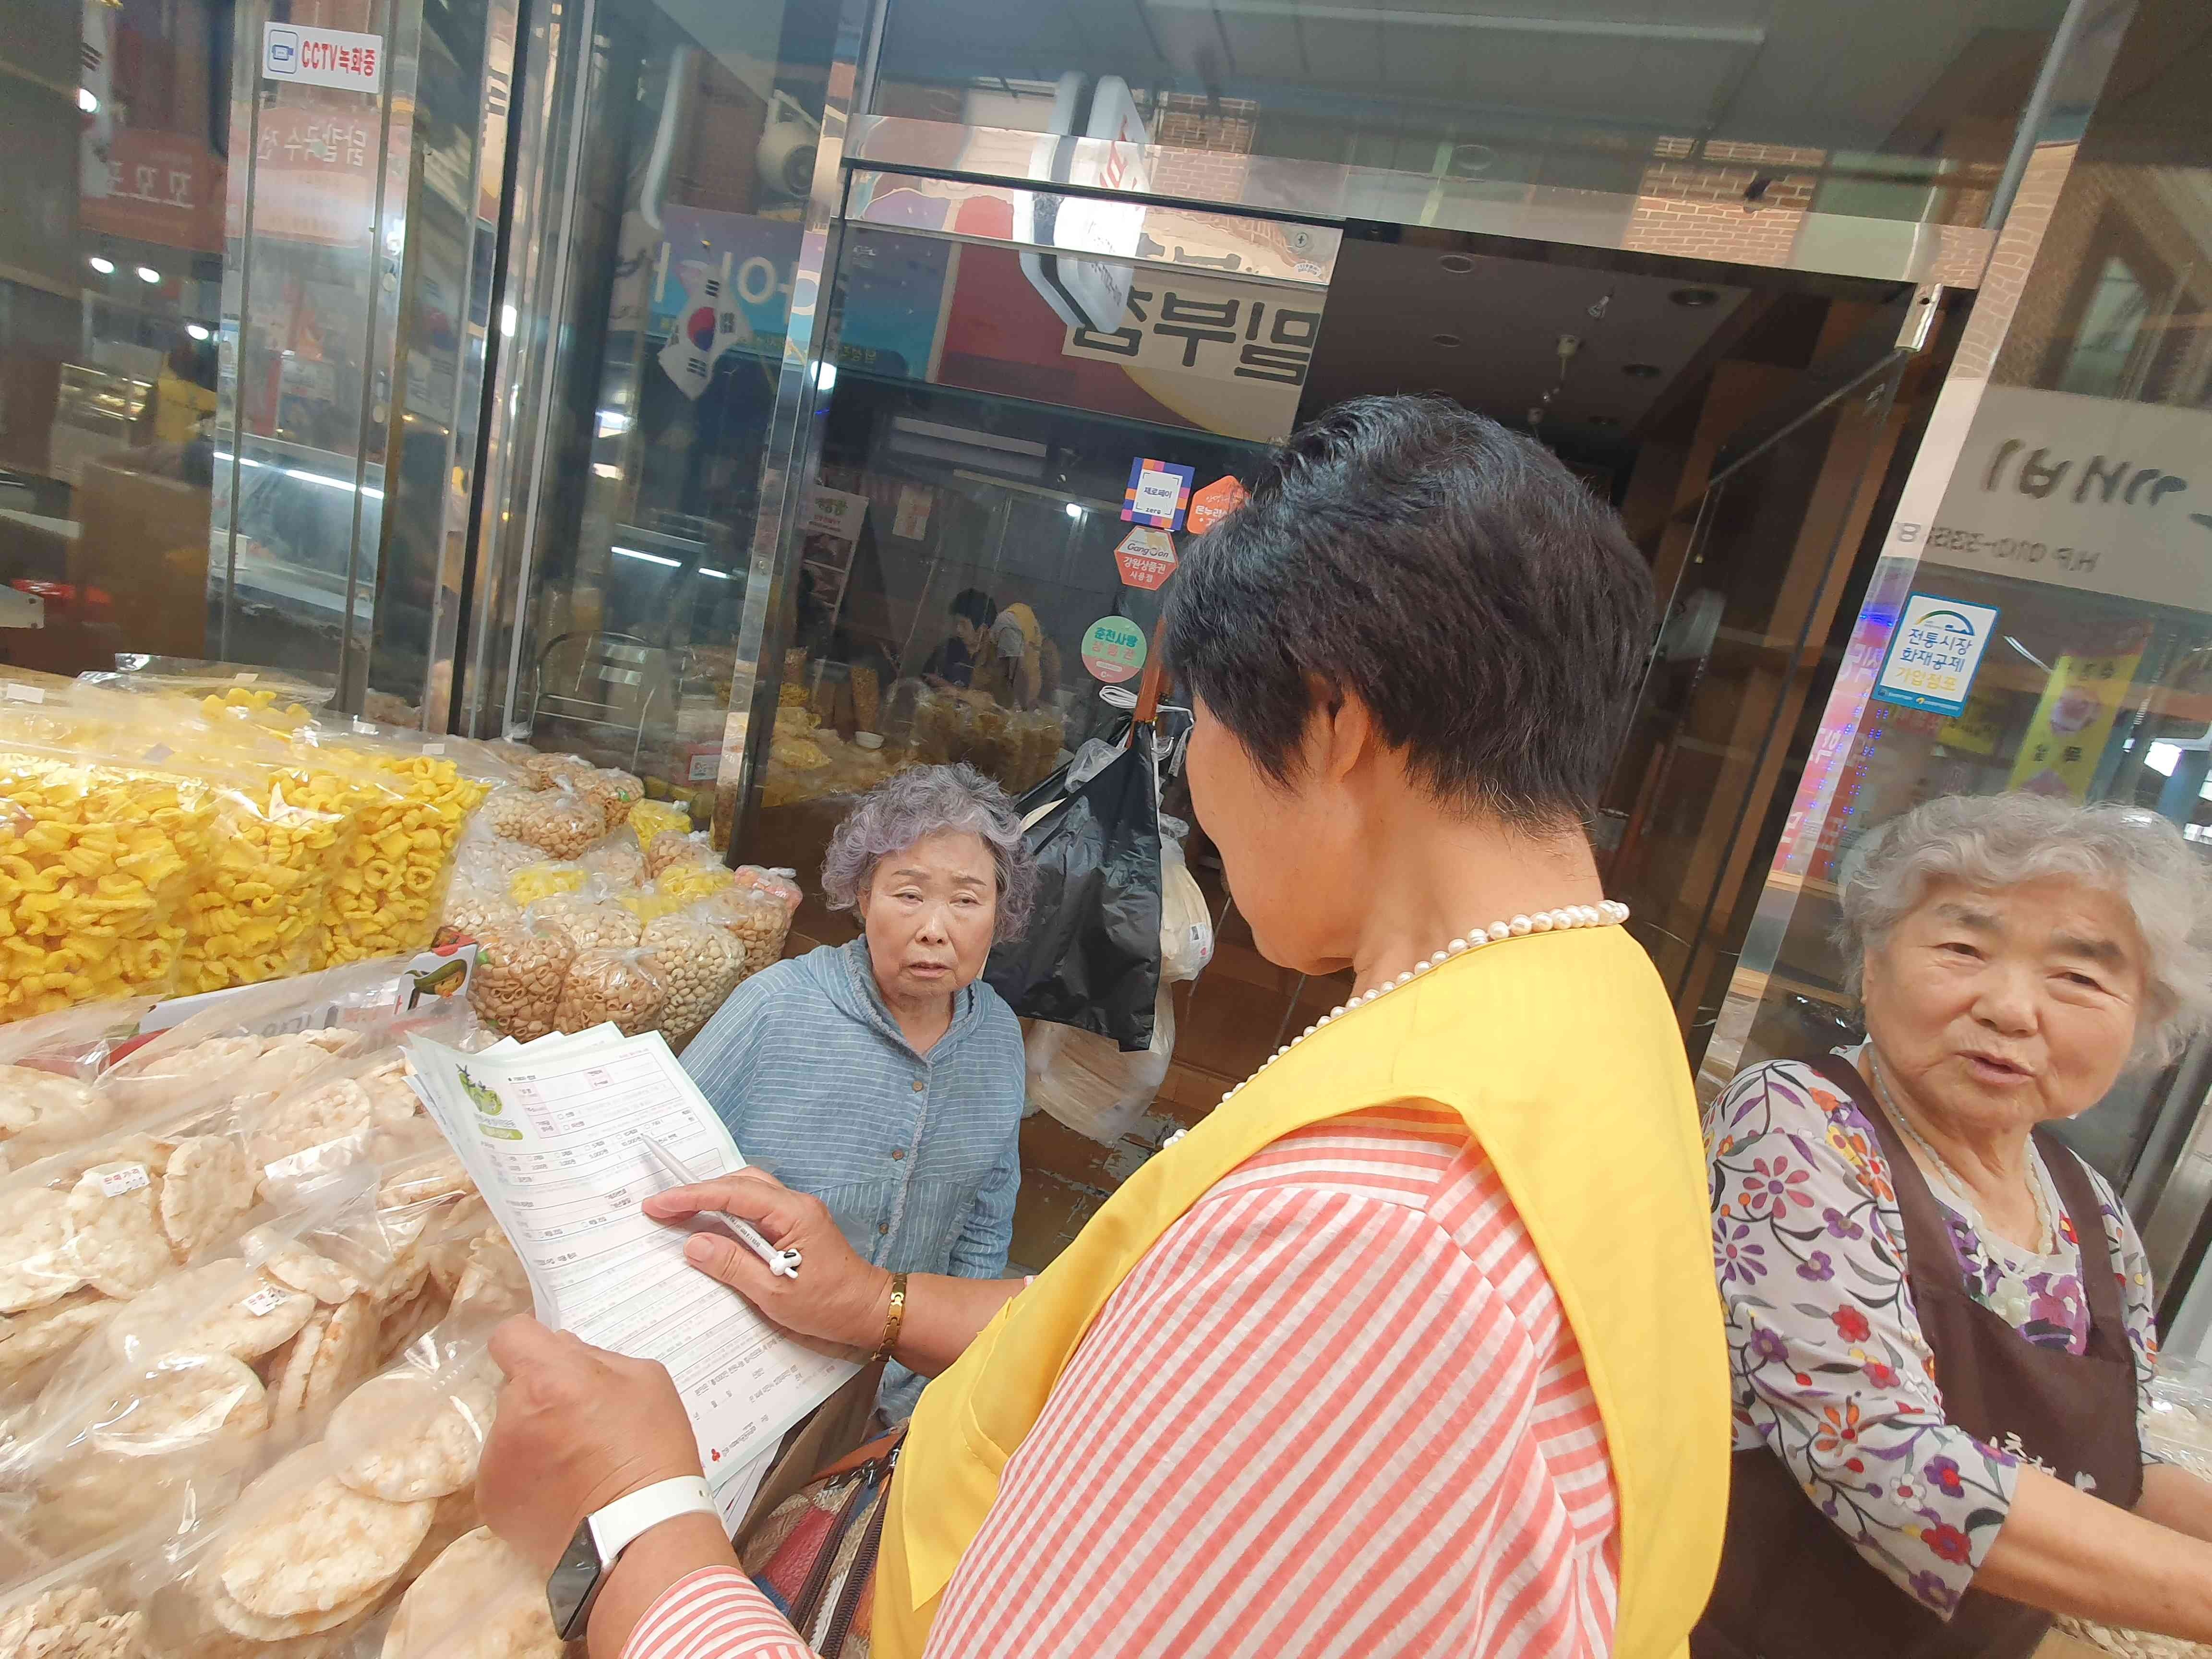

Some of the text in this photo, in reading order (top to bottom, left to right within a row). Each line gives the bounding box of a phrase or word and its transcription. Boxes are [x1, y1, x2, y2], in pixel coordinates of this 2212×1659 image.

[1123, 556, 1166, 574] 강원상품권
[1909, 628, 1973, 655] 전통시장
[1899, 648, 1965, 673] 화재공제
[1896, 667, 1958, 691] 가입점포
